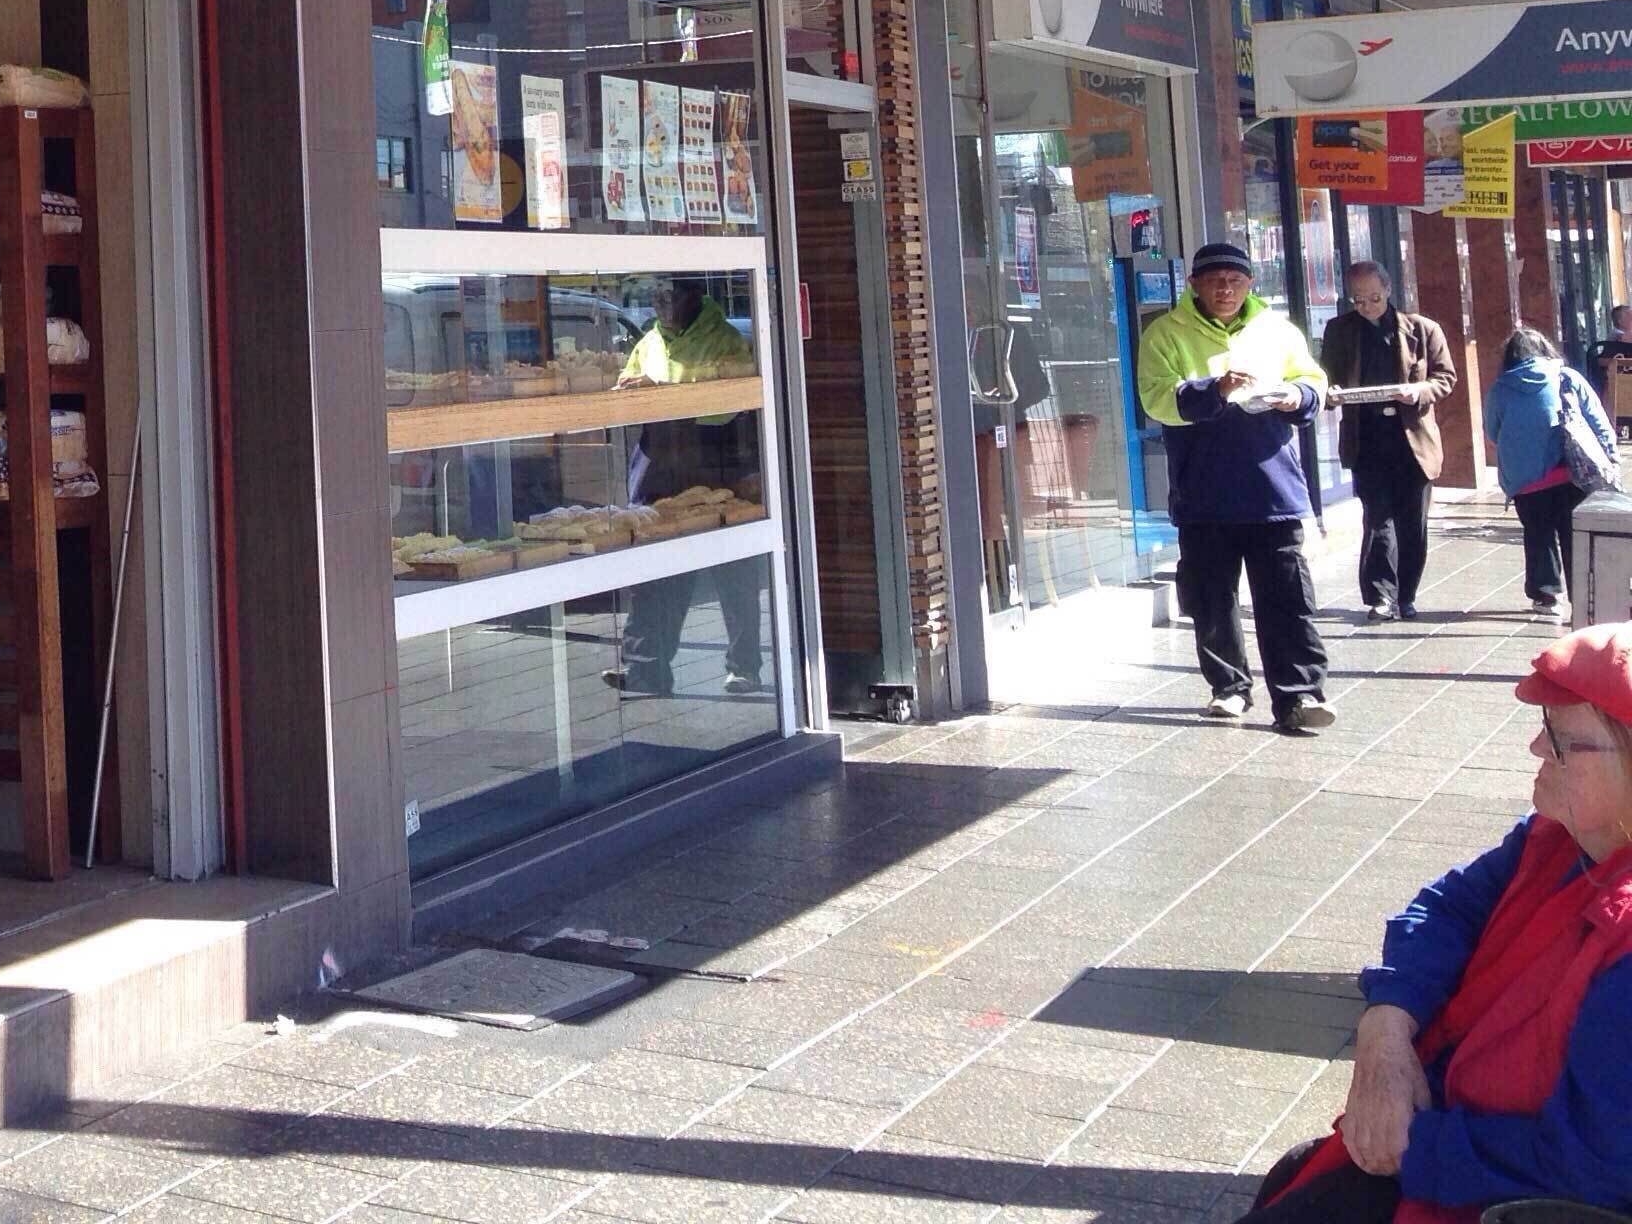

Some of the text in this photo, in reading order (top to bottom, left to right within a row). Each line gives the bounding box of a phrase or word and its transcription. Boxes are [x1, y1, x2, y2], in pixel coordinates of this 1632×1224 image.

[1460, 100, 1632, 126] EGALFLOW
[1309, 159, 1360, 172] Get your
[1348, 173, 1376, 184] here
